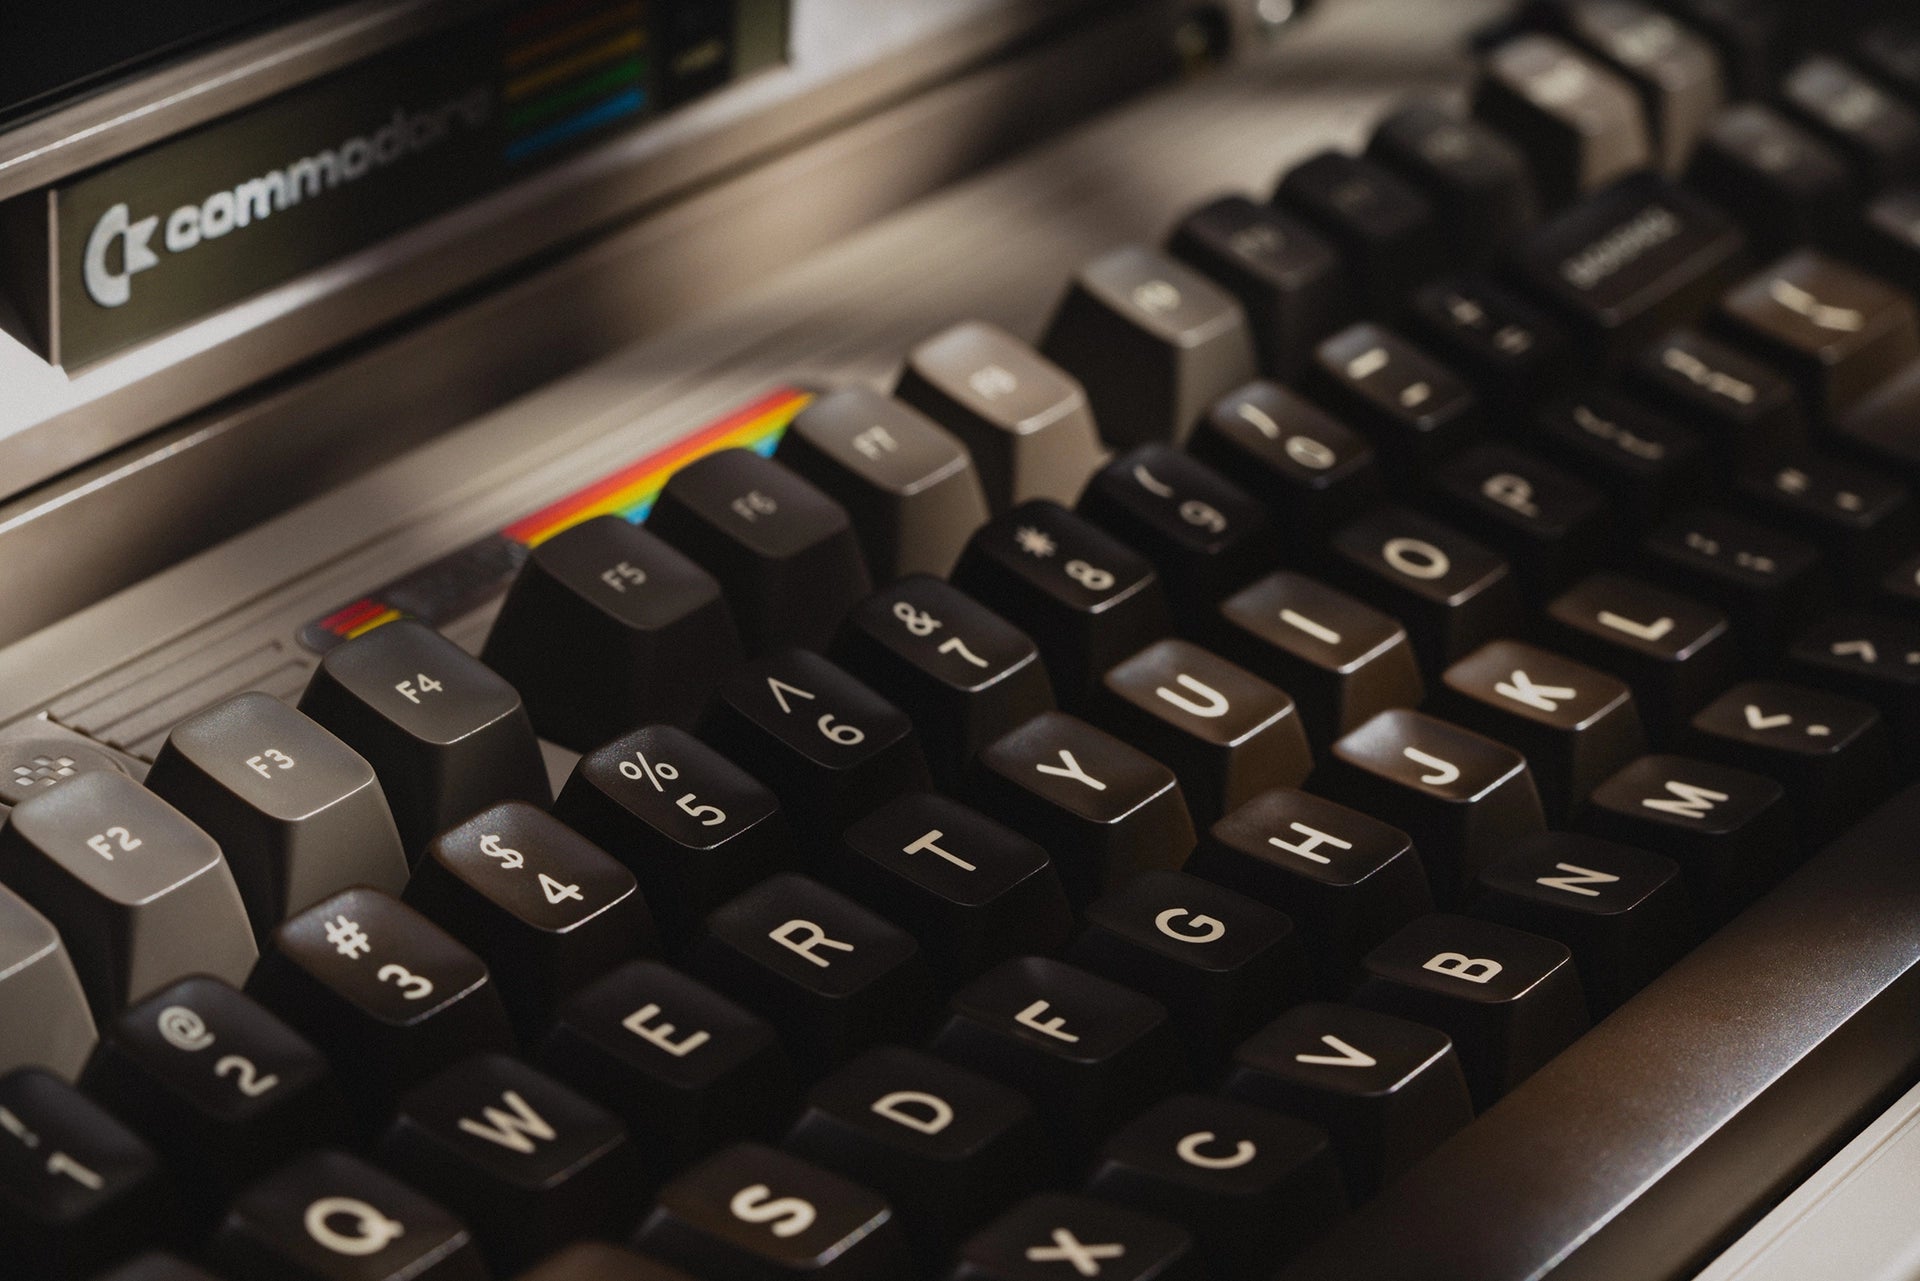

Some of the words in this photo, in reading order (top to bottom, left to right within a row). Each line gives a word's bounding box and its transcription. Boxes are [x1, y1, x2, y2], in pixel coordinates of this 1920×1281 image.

[164, 84, 494, 253] commodore
[1180, 501, 1226, 532] 9
[601, 562, 646, 592] F5
[1066, 561, 1114, 590] 8
[1383, 539, 1449, 579] O
[893, 602, 941, 636] &
[1598, 611, 1673, 641] L
[938, 637, 988, 668] 7
[395, 673, 443, 704] F4
[1156, 673, 1230, 718] U
[1494, 669, 1576, 712] K
[817, 713, 865, 746] 6
[245, 748, 295, 780] F3
[618, 751, 679, 792] %
[1036, 749, 1107, 791] Y
[1402, 746, 1460, 786] J
[675, 793, 727, 826] 5
[1642, 780, 1728, 819] M
[86, 826, 143, 861] F2
[479, 833, 524, 869] $
[902, 829, 977, 872] T
[1268, 821, 1353, 865] H
[537, 873, 584, 905] 4
[1536, 862, 1620, 897] N
[324, 915, 371, 959] #
[768, 919, 854, 968] R
[1154, 907, 1226, 944] G
[377, 963, 433, 1000] 3
[1422, 952, 1503, 984] B
[157, 1005, 214, 1050] @
[622, 1003, 710, 1056] E
[1014, 999, 1079, 1043] F
[1295, 1034, 1377, 1067] V
[215, 1055, 278, 1096] 2
[460, 1091, 555, 1153] W
[872, 1091, 953, 1134] D
[1177, 1132, 1256, 1169] C
[47, 1153, 102, 1189] 1
[305, 1198, 402, 1255] Q
[731, 1185, 816, 1237] S
[1027, 1229, 1123, 1275] X
